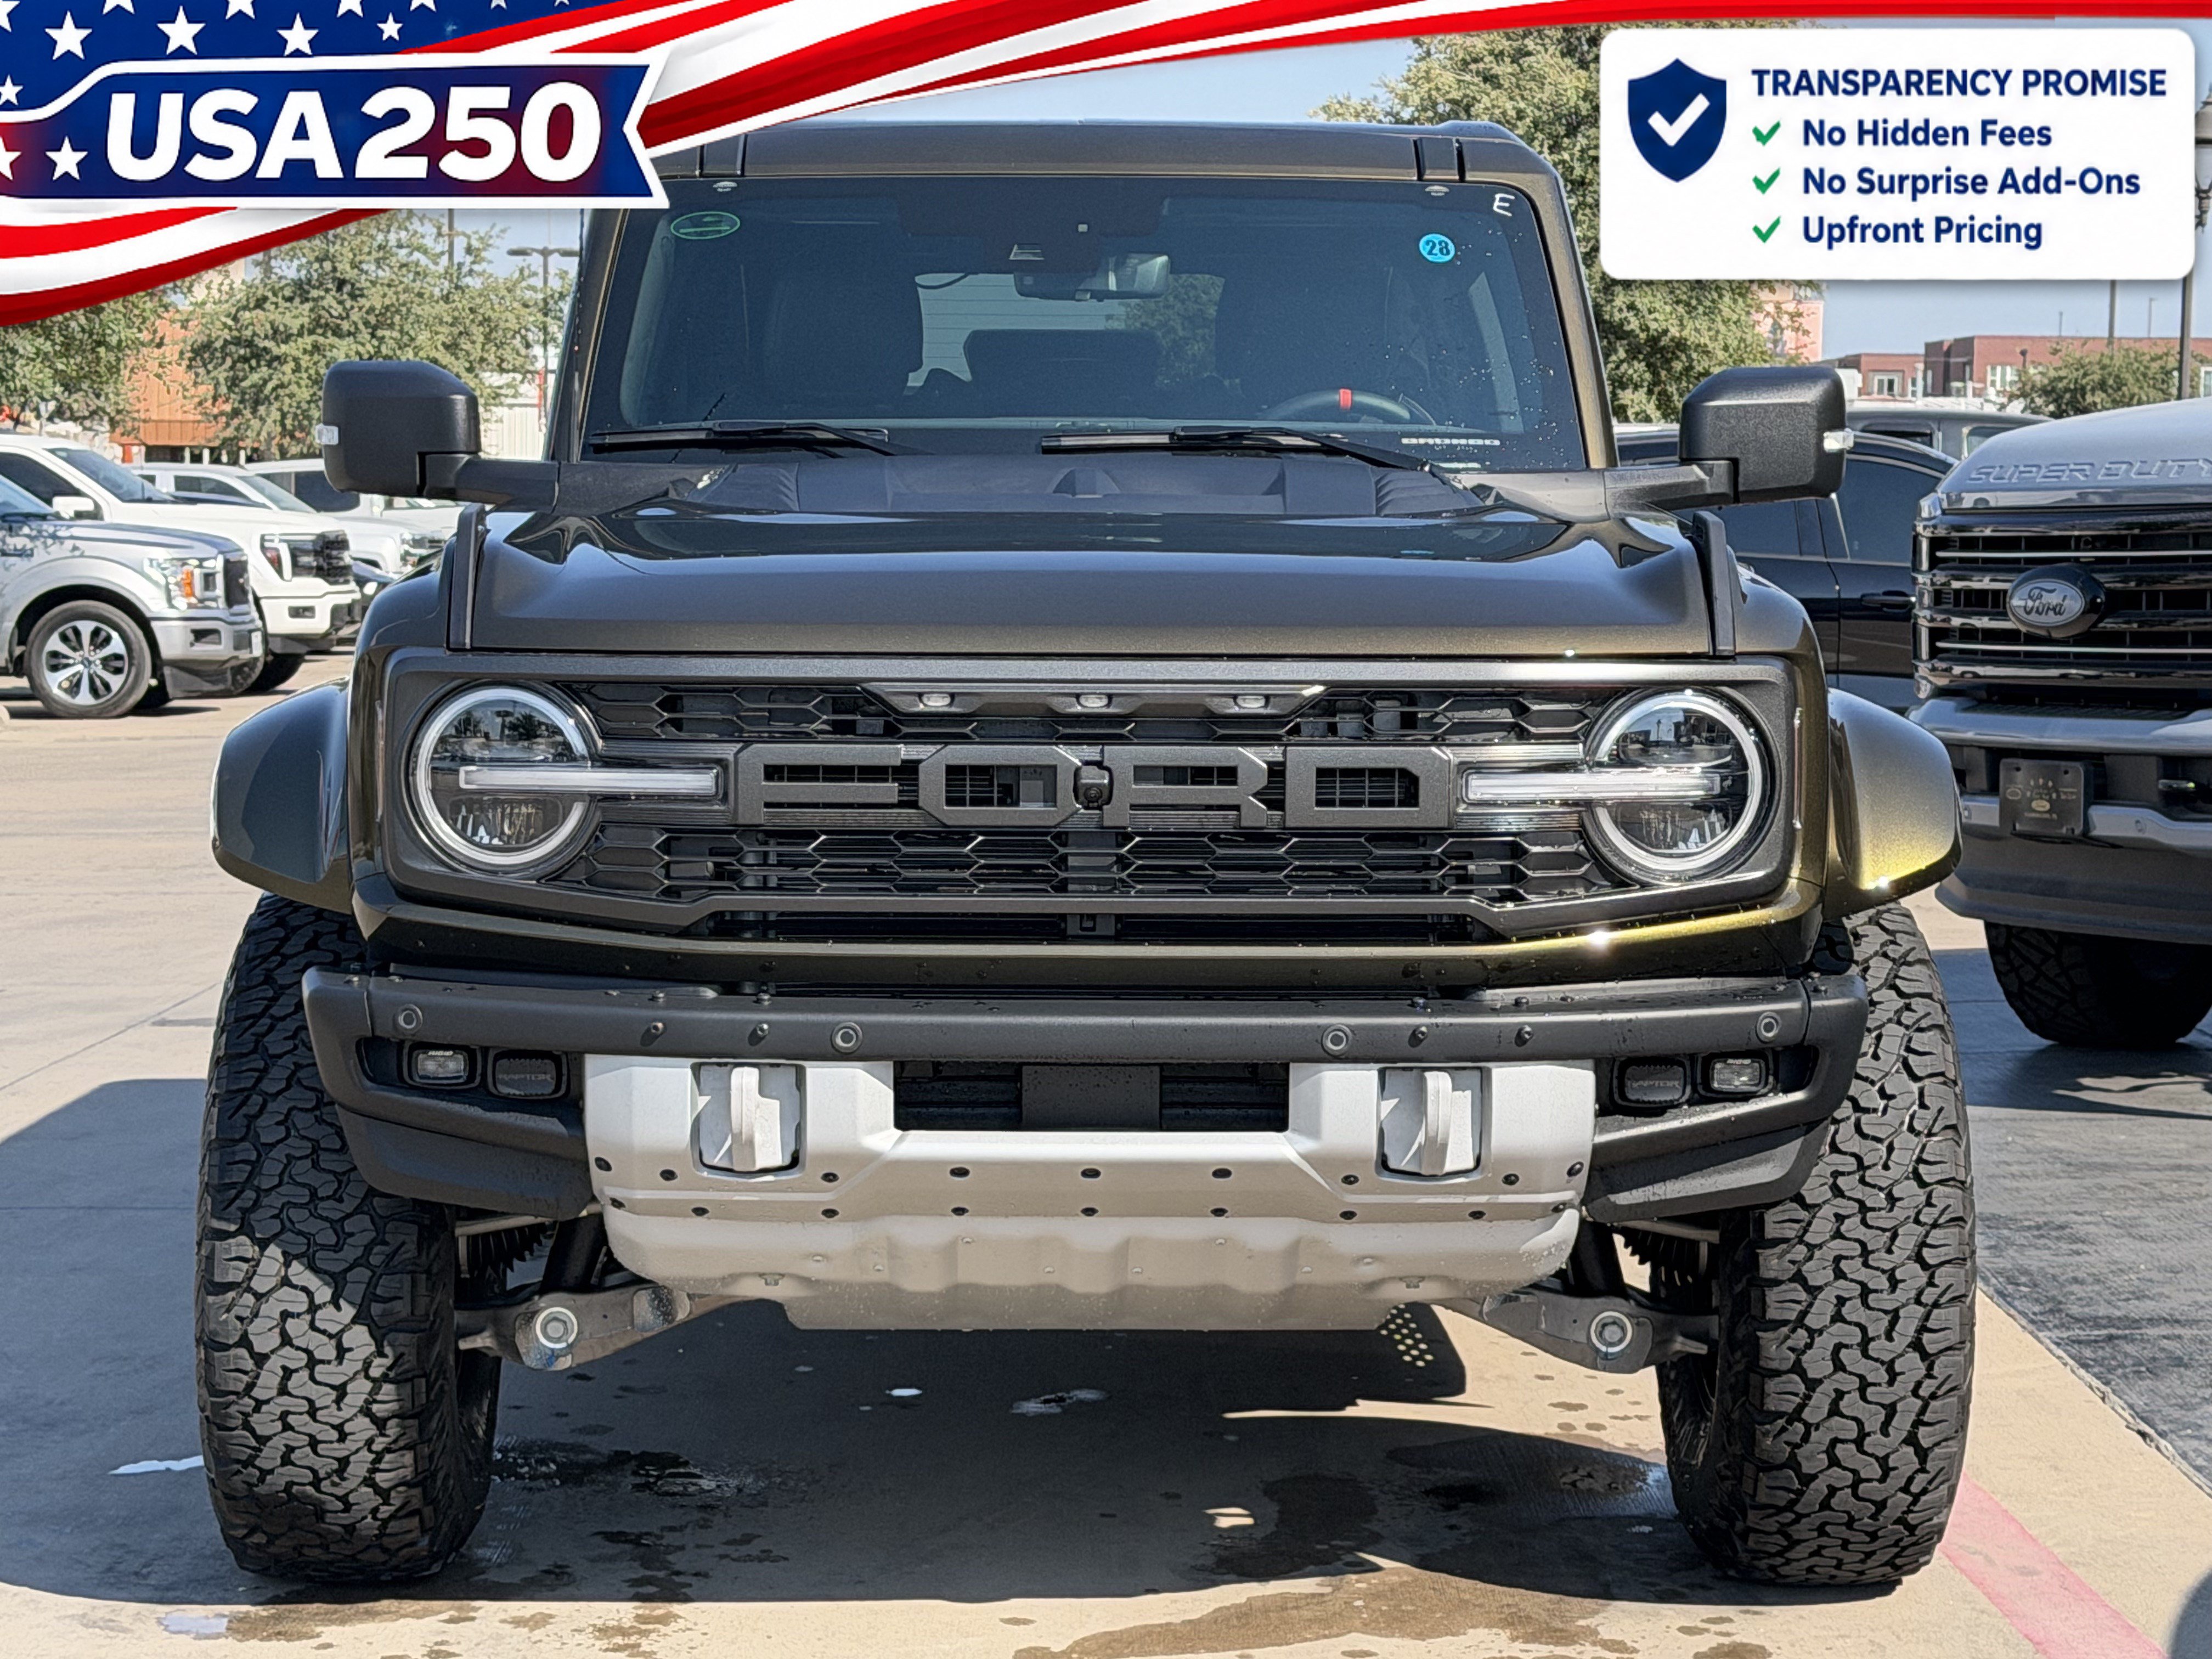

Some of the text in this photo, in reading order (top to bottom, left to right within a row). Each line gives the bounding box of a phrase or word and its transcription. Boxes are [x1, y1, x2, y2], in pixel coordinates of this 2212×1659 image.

[1493, 193, 1515, 217] E
[1426, 239, 1451, 257] 28
[1966, 463, 2095, 483] SUPER
[2022, 586, 2068, 617] Ford
[736, 744, 1451, 828] FORD
